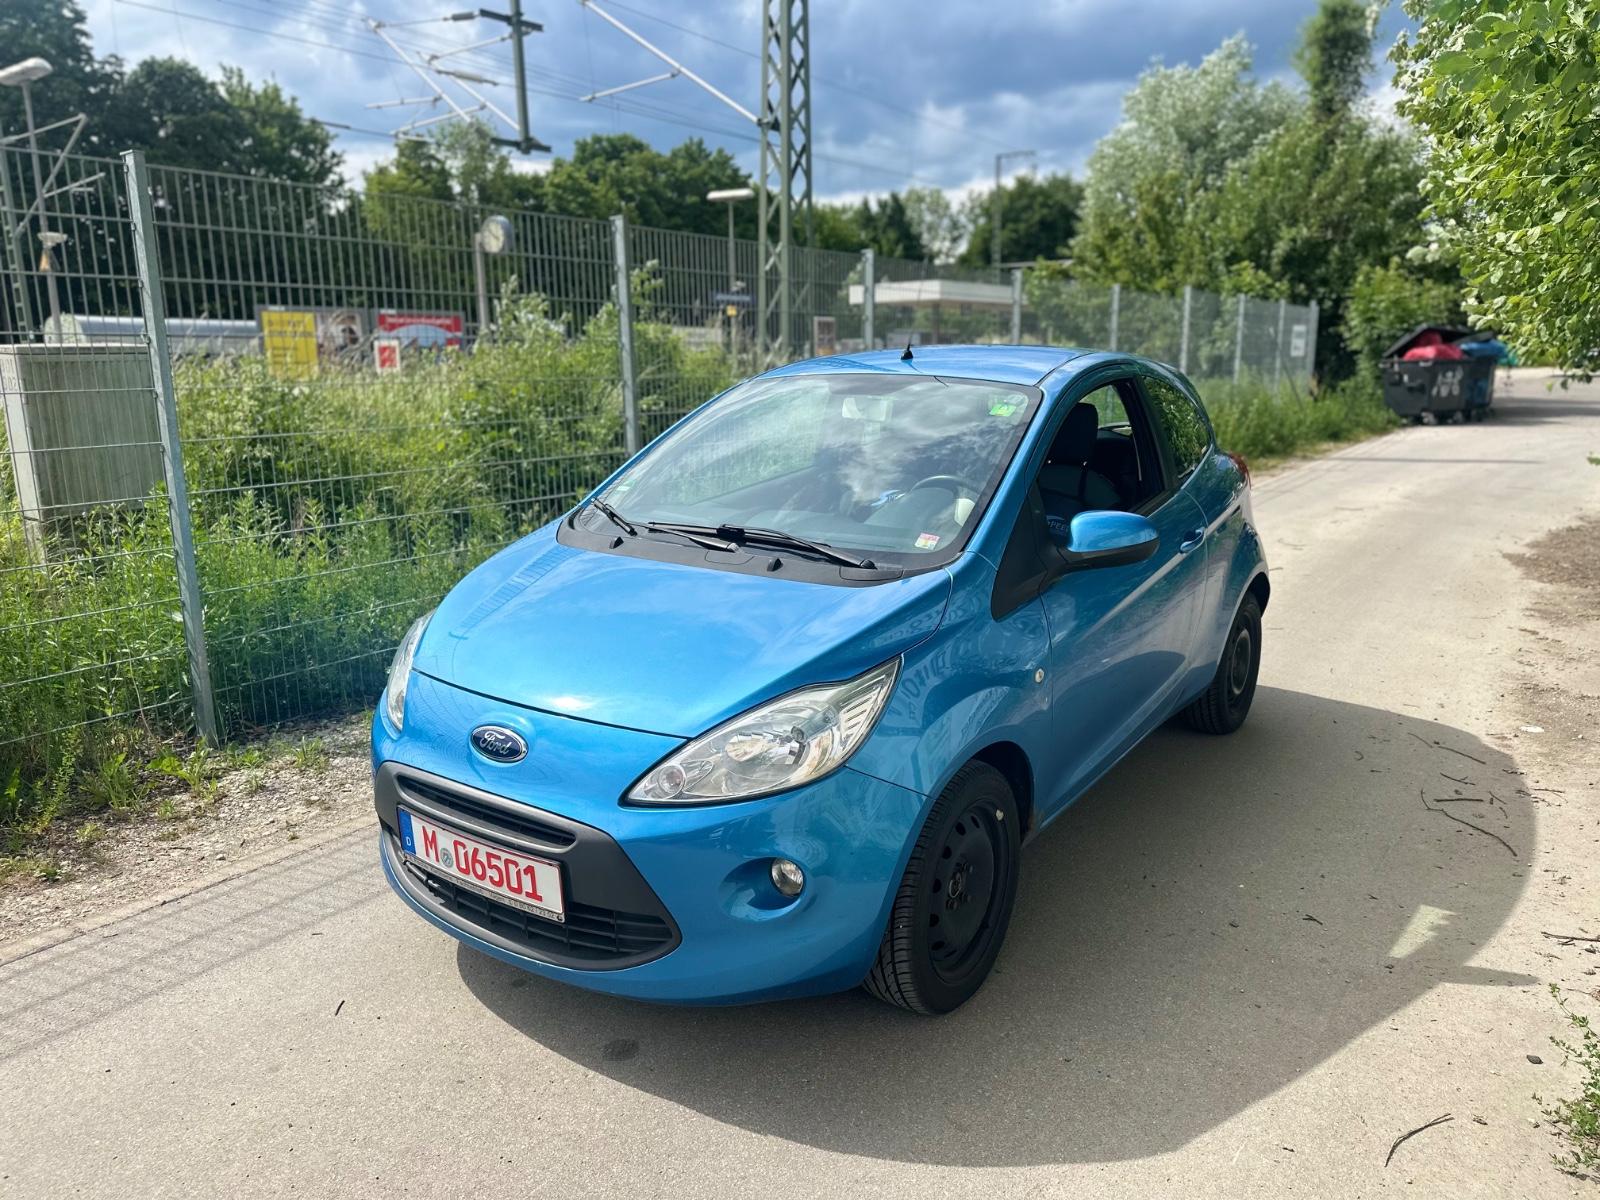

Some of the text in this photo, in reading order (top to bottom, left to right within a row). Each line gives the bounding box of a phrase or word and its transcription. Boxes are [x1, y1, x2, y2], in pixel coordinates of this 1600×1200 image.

[480, 731, 511, 755] Ford
[406, 836, 412, 846] D
[422, 825, 543, 902] M 06501
